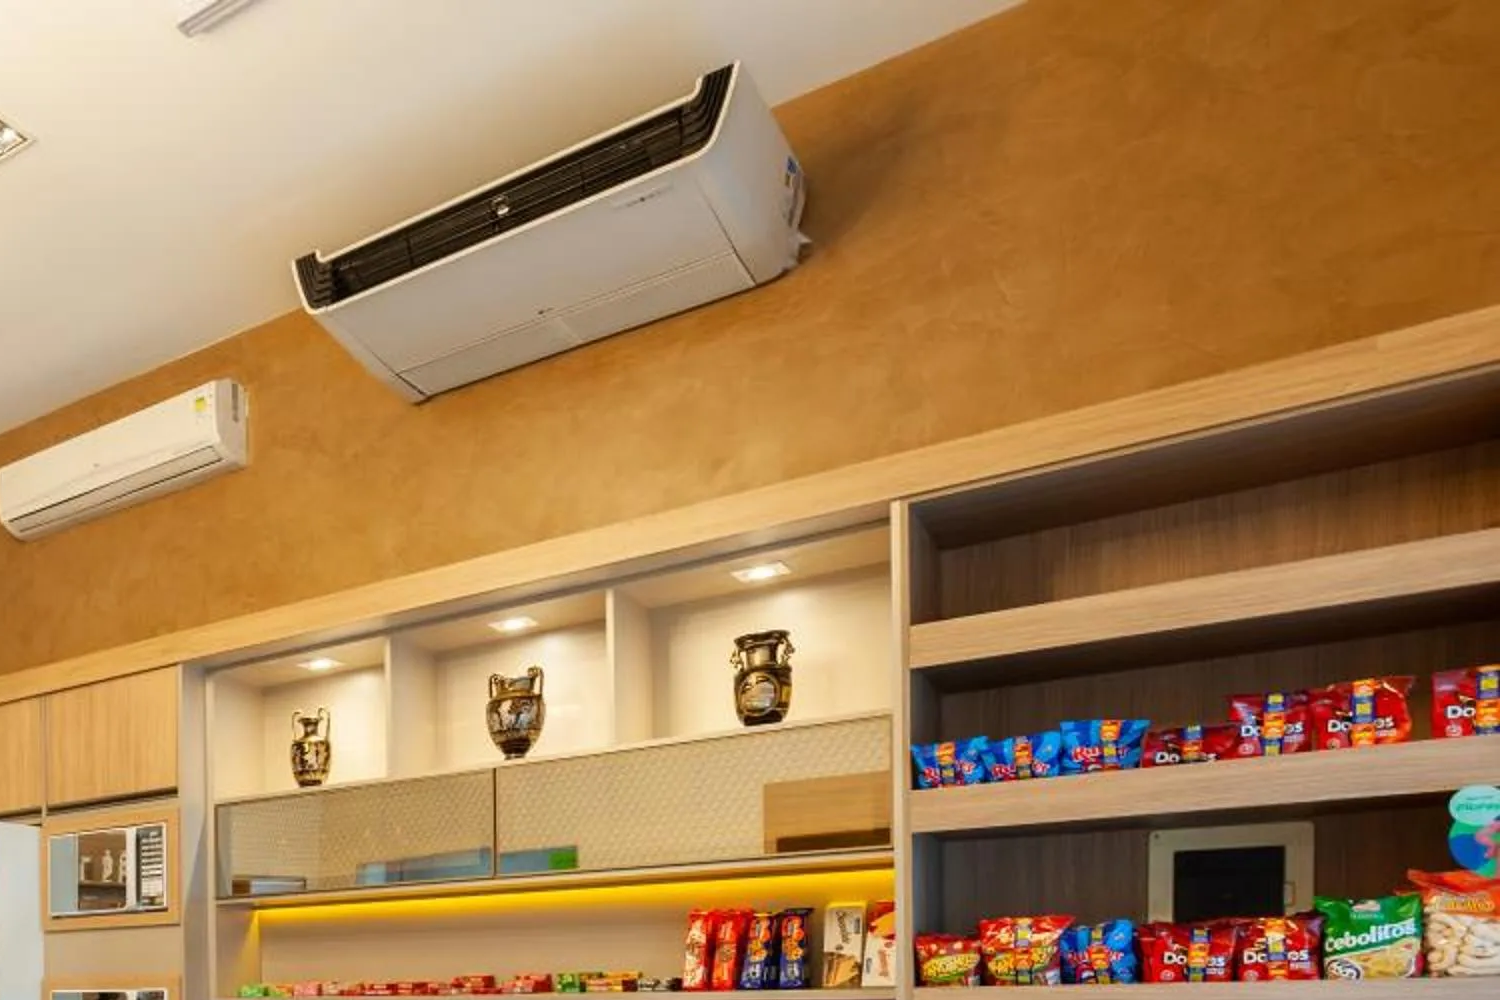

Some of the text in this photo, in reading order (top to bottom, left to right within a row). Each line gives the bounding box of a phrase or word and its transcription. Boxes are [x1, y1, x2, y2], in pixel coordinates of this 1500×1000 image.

[1240, 721, 1303, 738] Doos
[1327, 716, 1394, 733] Doos
[1163, 951, 1225, 967] Doos
[1243, 949, 1309, 965] Doos
